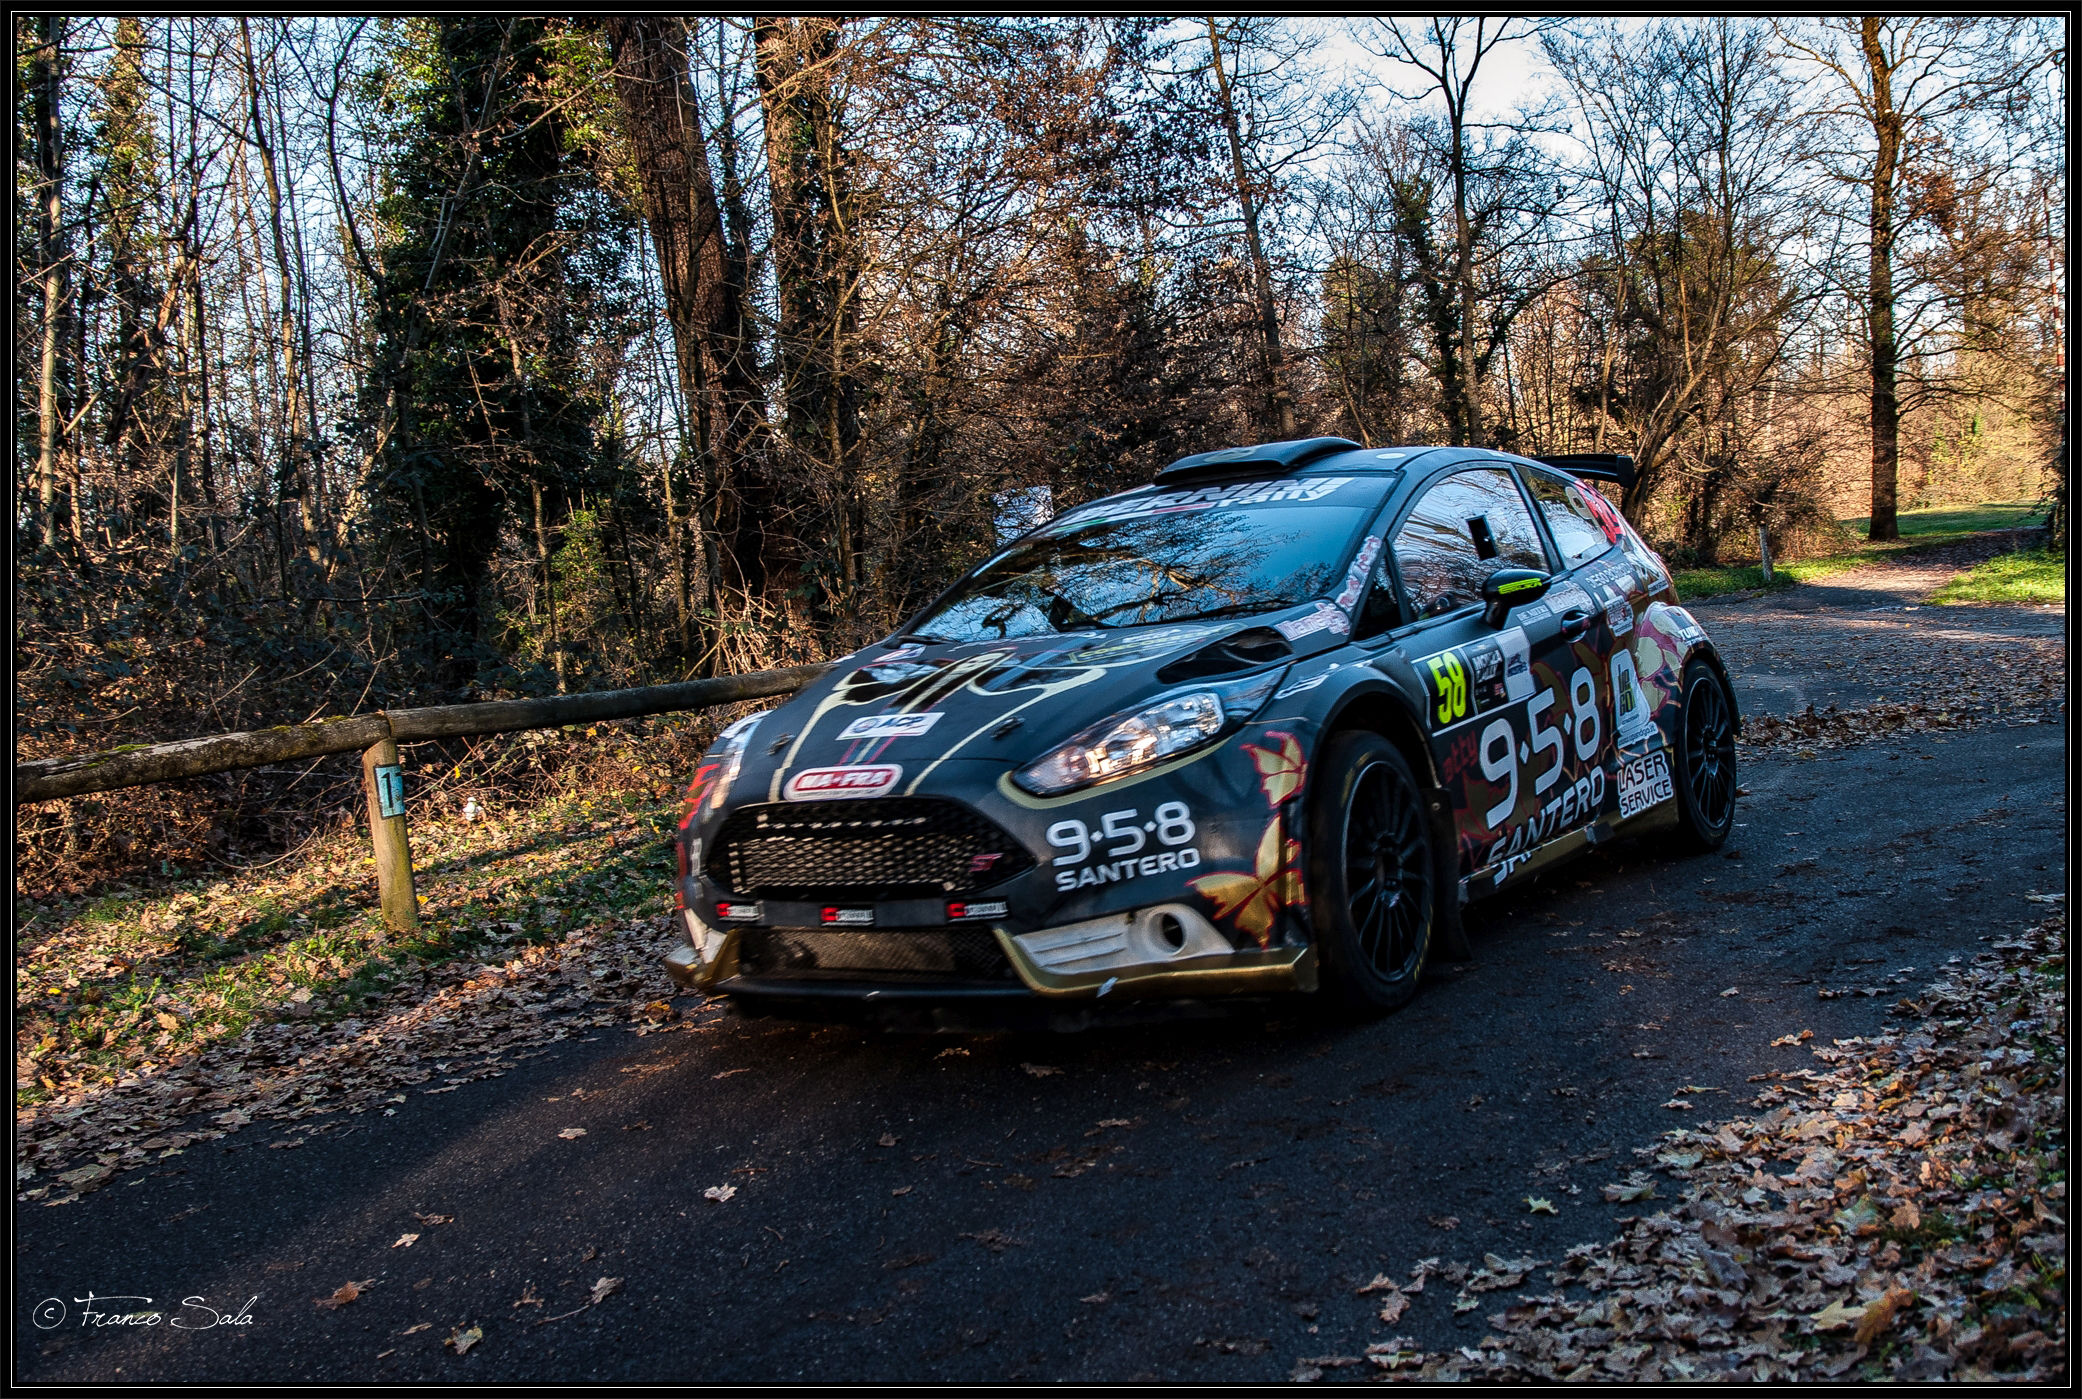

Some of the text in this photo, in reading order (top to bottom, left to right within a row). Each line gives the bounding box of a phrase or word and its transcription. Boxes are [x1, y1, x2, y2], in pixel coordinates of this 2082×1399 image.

[1426, 651, 1467, 725] 58
[1617, 754, 1668, 794] LASER
[1620, 778, 1673, 817] SERVICE
[1054, 847, 1201, 892] SANTERO
